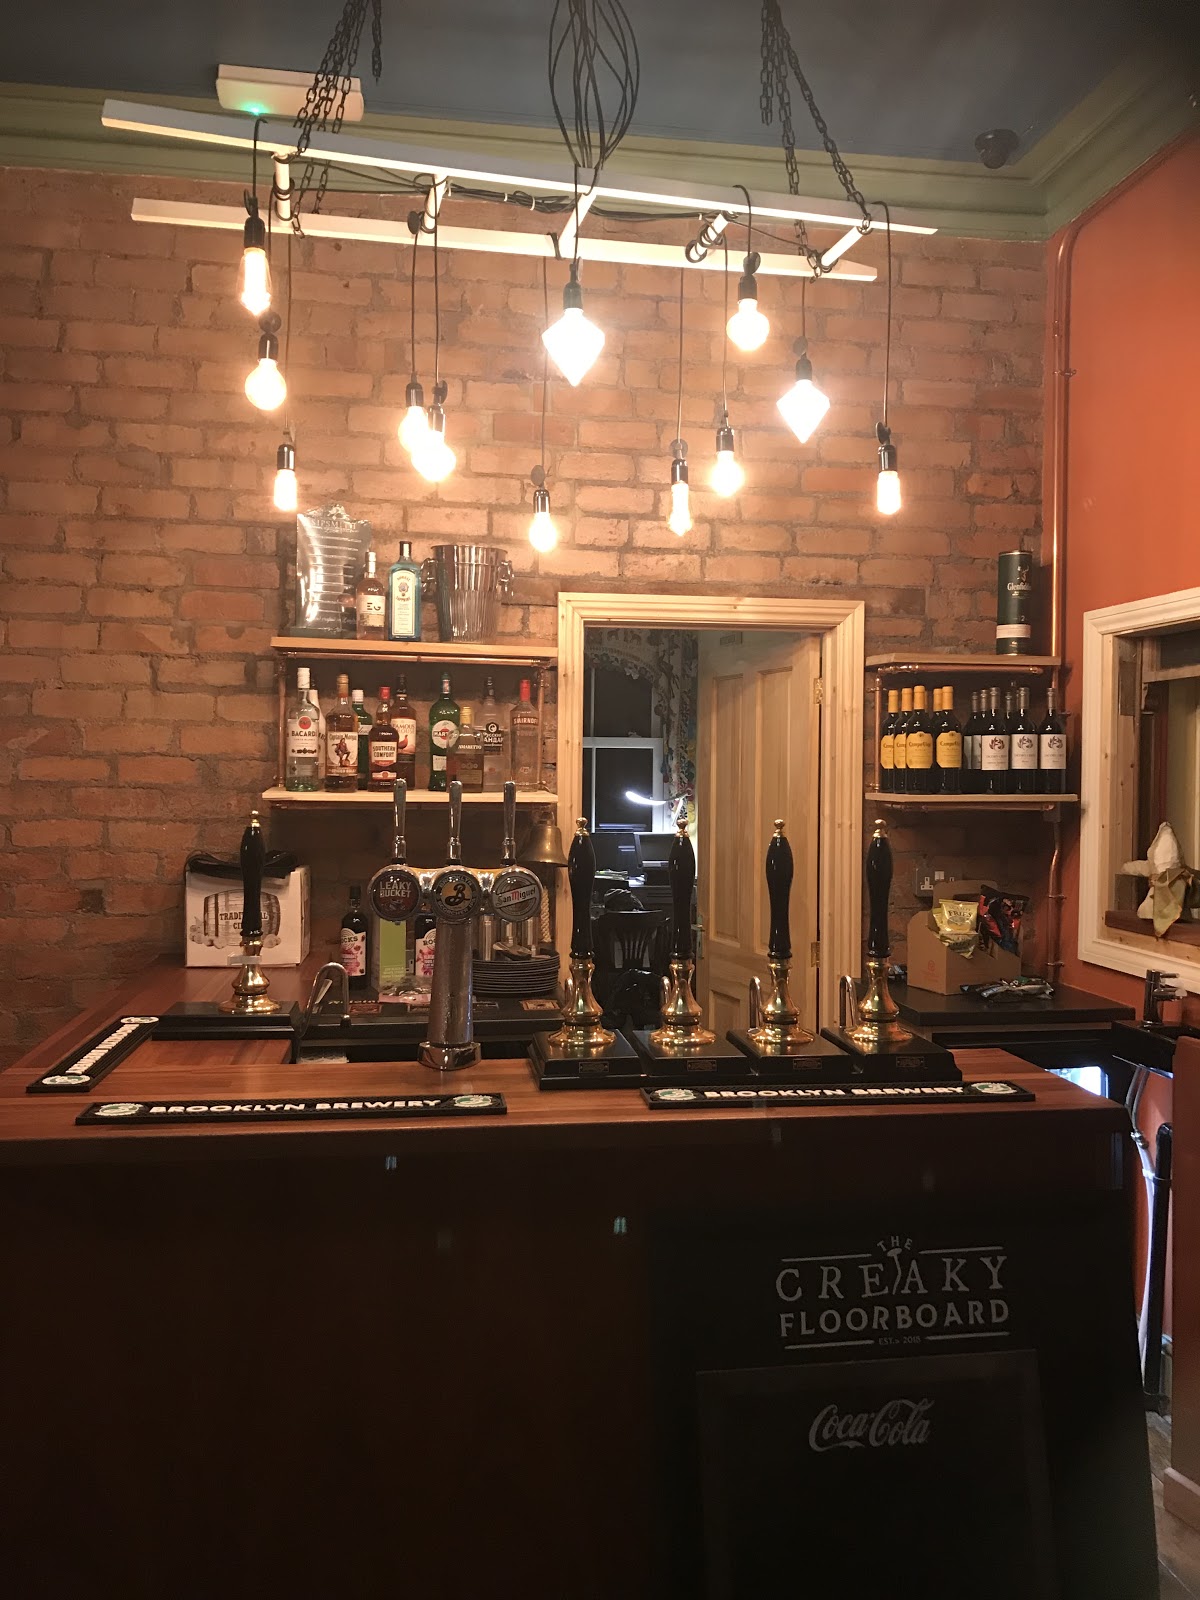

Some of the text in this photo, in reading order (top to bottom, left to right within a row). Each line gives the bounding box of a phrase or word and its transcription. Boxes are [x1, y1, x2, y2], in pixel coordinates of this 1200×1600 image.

[380, 881, 412, 890] LEAKY
[380, 889, 412, 898] BUCKET
[704, 1088, 846, 1099] BROOKLYN
[851, 1086, 964, 1096] BREWERY
[150, 1103, 305, 1113] BROOKLYN
[316, 1099, 441, 1110] BREWERY
[877, 1235, 913, 1252] THE
[776, 1255, 1007, 1301] CREAKY
[780, 1299, 1009, 1337] FLOORBOARD
[808, 1397, 935, 1452] Coca-Cola
